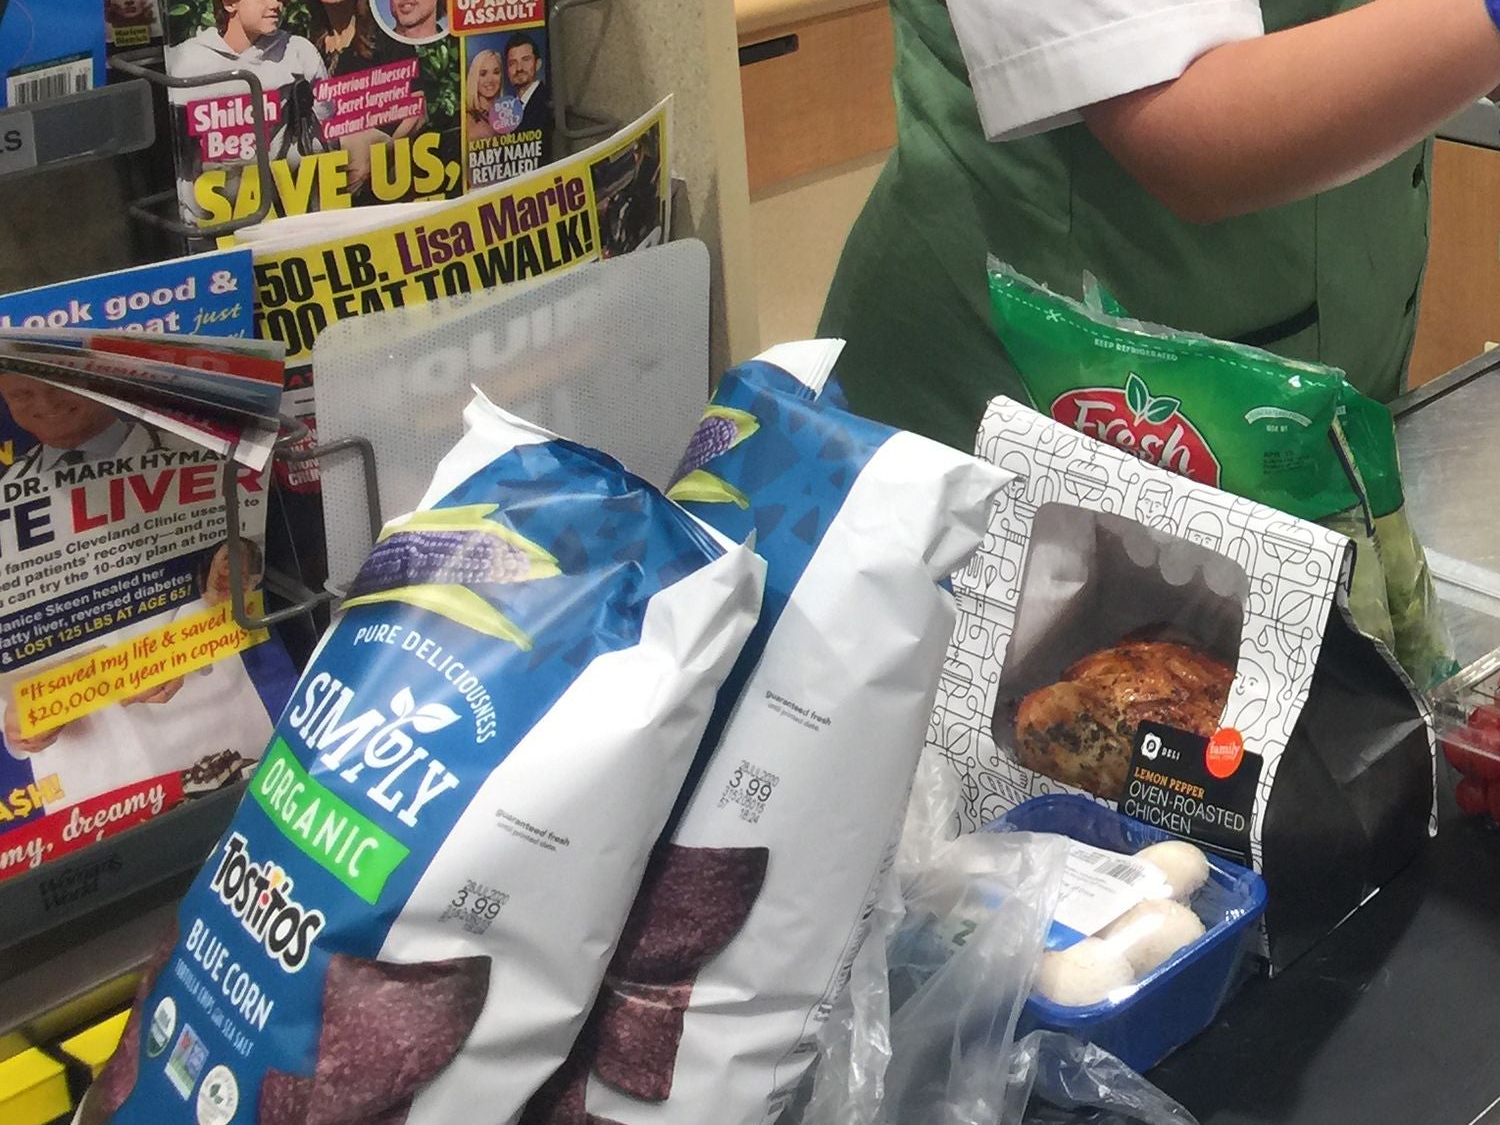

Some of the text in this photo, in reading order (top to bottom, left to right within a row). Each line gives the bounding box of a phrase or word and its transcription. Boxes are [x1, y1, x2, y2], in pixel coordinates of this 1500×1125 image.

[463, 2, 537, 26] ASSAULT
[317, 60, 417, 100] Mysterious Illnesses!
[336, 82, 410, 116] Secret Surgeries!
[323, 98, 424, 139] Constant Surveillance!
[207, 131, 258, 161] Beg
[469, 140, 543, 169] BABY NAME
[194, 132, 461, 228] SAVE US,
[254, 175, 587, 309] 50-LB. Lisa Marie
[1073, 398, 1197, 476] Fresh
[4, 448, 227, 503] DR. MARK HYMA
[4, 496, 260, 576] famous Cleveland Clinic uses to
[1, 584, 192, 665] & LOST 125 LBS AT AGE 65!
[353, 624, 498, 744] PURE DELICIOUSNESS
[289, 671, 461, 828] SIMPLY
[1161, 746, 1181, 761] DELI
[728, 769, 744, 789] 3
[745, 778, 772, 803] 99
[1128, 779, 1246, 833] OVEN-ROASTED
[1133, 766, 1206, 800] LEMON PEPPER
[260, 758, 380, 878] ORGANIC
[1124, 798, 1192, 835] CHICKEN
[451, 889, 469, 908] 3
[471, 897, 501, 920] 99
[185, 917, 275, 1032] BLUE CORN
